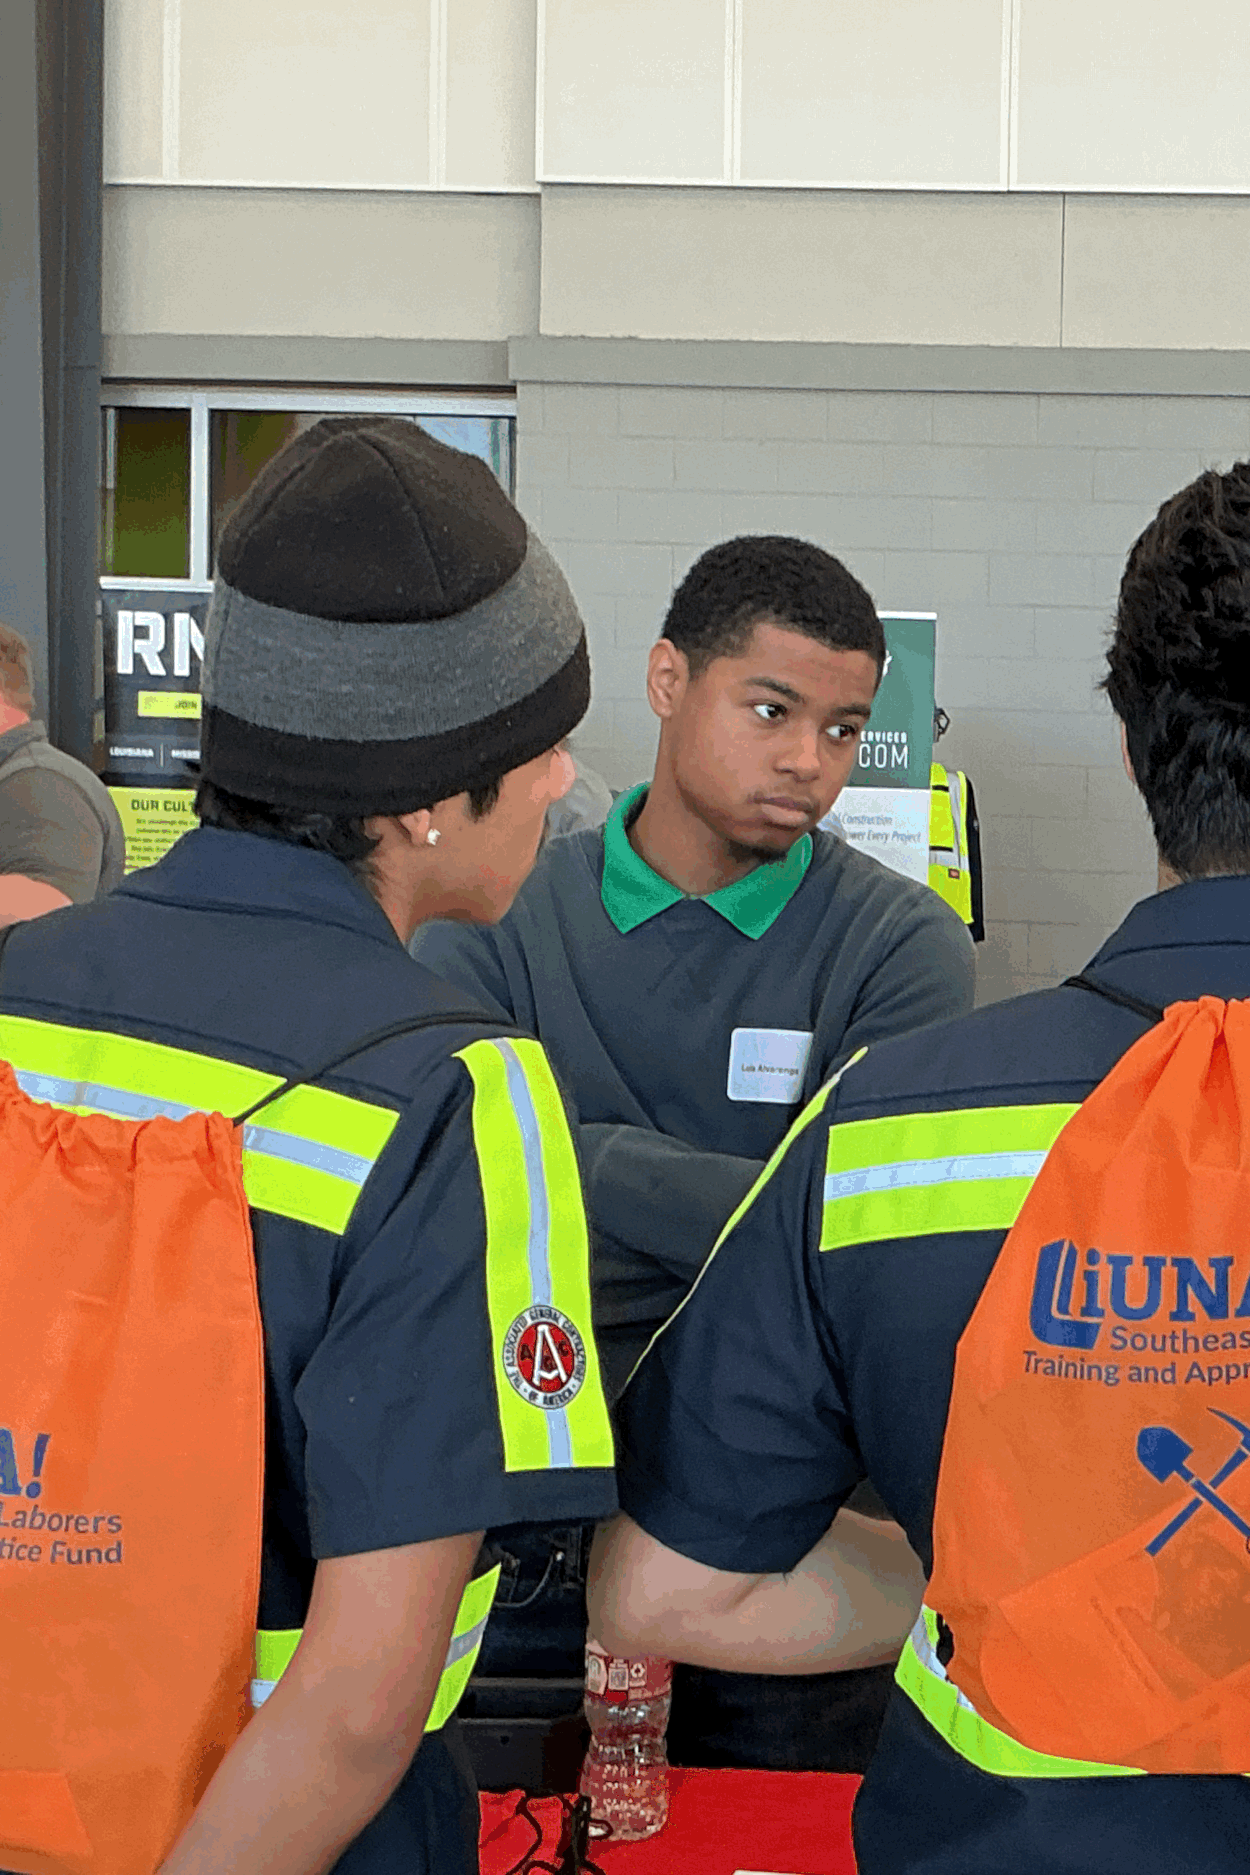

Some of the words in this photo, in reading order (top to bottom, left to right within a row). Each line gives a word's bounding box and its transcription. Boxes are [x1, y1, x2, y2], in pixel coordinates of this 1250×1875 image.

[860, 730, 908, 744] ERVICES
[858, 743, 908, 769] COM
[131, 799, 159, 811] OUR
[1022, 1350, 1121, 1387] Training
[1127, 1362, 1177, 1384] and
[50, 1540, 123, 1565] Fund
